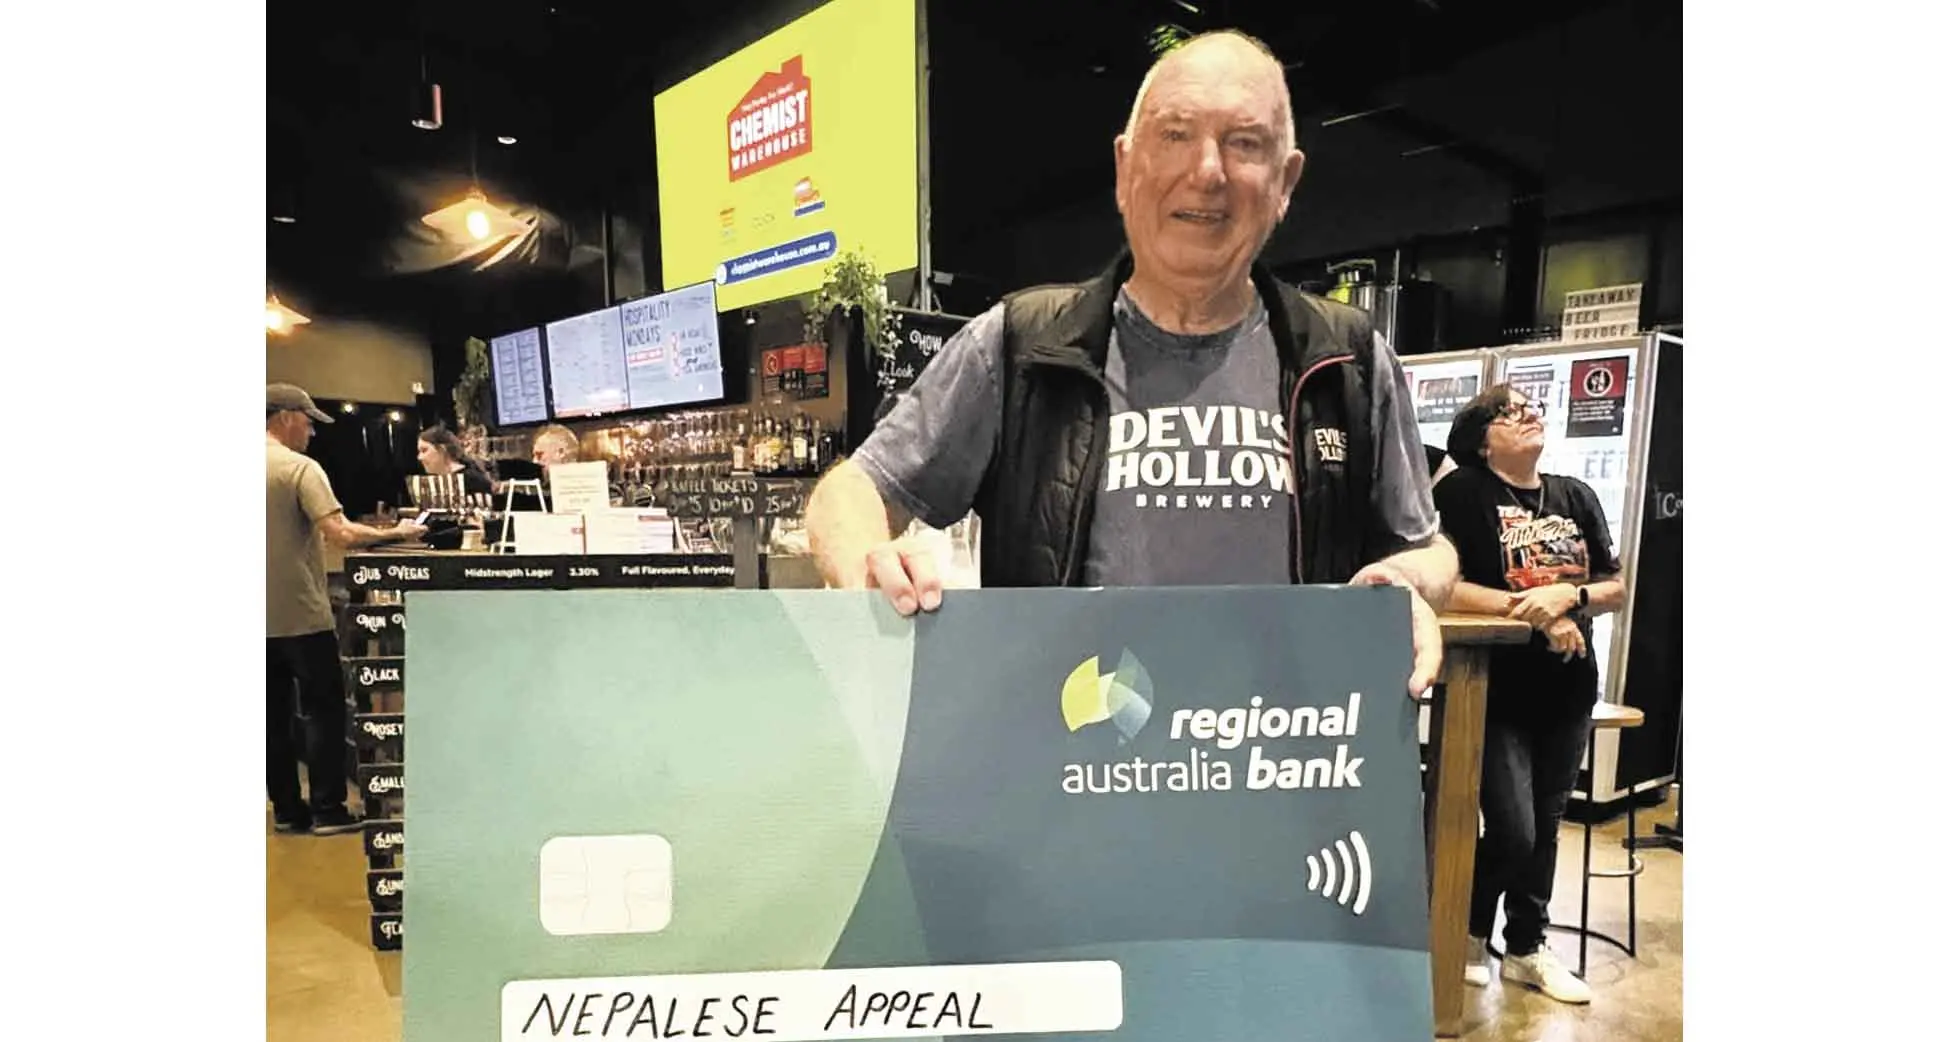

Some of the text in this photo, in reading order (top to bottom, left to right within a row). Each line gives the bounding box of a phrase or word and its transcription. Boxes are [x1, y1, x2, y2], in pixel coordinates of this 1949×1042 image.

[730, 88, 808, 152] CHEMIST
[731, 127, 806, 171] WAREHOUSE
[1567, 288, 1635, 308] TAKEAWAY
[625, 300, 671, 326] HOSPITALITY
[1565, 311, 1600, 326] BEER
[626, 325, 661, 347] MONDAYS
[909, 329, 942, 356] HOW
[1575, 325, 1628, 339] FRIDGE
[1109, 405, 1291, 453] DEVIL'S
[1105, 450, 1294, 494] HOLLOW
[1136, 494, 1273, 509] BREWERY
[388, 565, 430, 580] VEGAS
[465, 567, 523, 579] Midstrength
[525, 568, 553, 579] Lager
[622, 566, 640, 575] Full
[693, 566, 735, 578] Everyday
[360, 666, 400, 685] BLACK
[1170, 692, 1361, 750] regional
[1061, 744, 1365, 794] australia bank
[521, 984, 994, 1038] NEPALESE APPEAL
